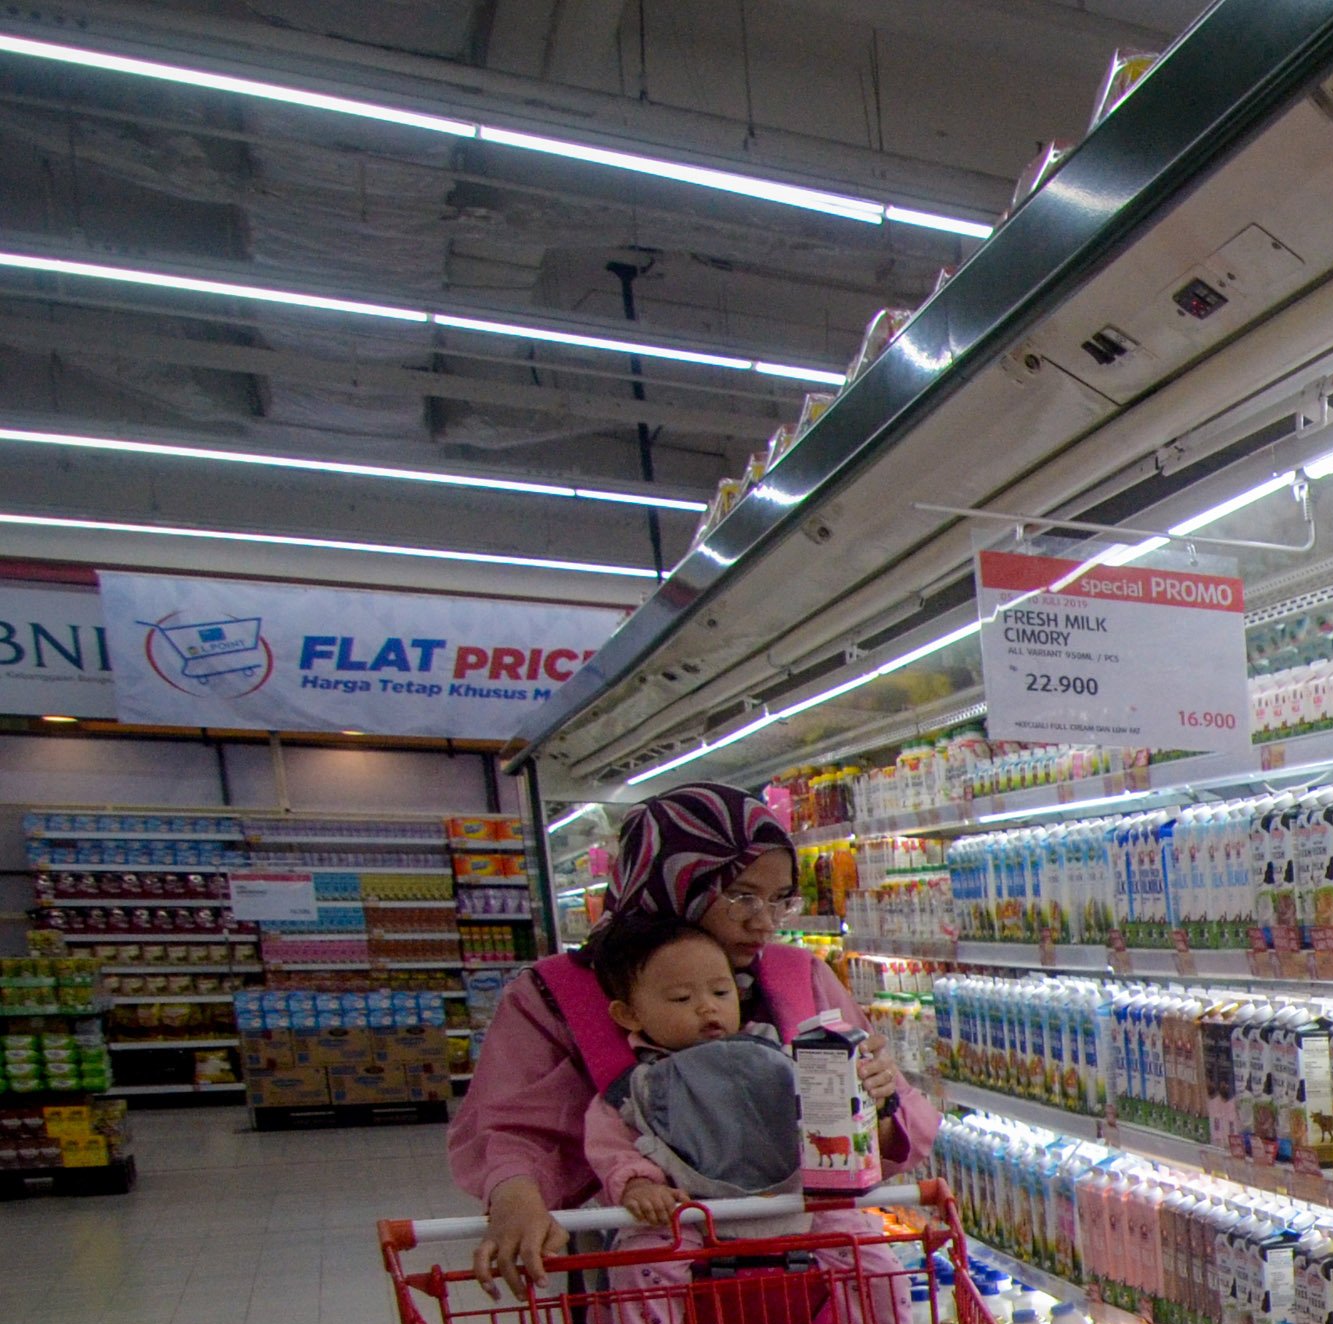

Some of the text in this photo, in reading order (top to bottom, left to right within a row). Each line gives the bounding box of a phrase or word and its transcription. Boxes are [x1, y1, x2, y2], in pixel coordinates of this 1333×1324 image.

[1081, 577, 1233, 607] special PROMO
[1003, 609, 1108, 632] FRESH MILK
[1004, 627, 1071, 647] CIMORY
[300, 635, 599, 682] FLAT PRIC
[301, 675, 528, 701] Harga Tetap Khusus
[1025, 673, 1099, 696] 22.900
[1178, 711, 1236, 730] 16.900
